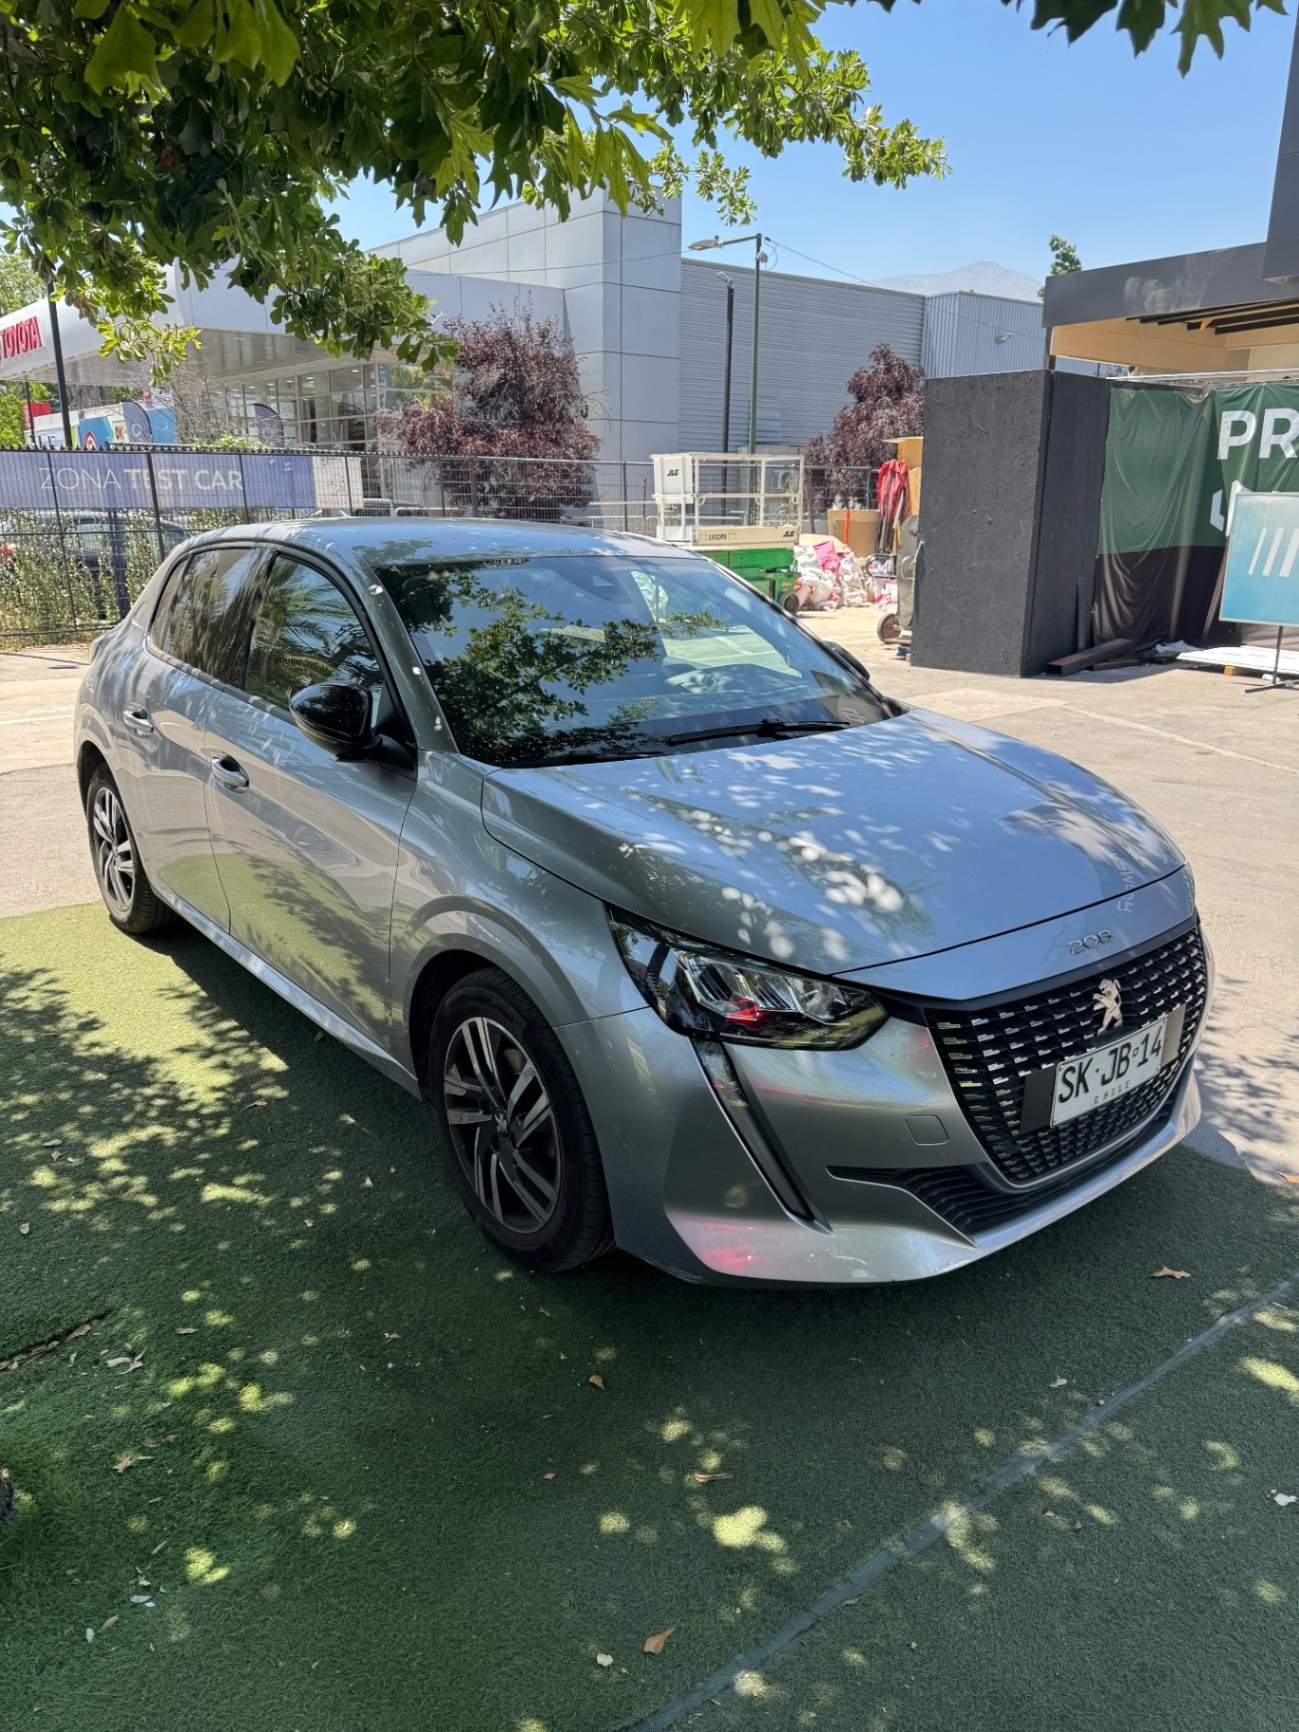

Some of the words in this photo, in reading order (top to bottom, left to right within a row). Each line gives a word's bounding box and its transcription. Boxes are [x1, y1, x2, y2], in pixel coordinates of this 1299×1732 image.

[0, 316, 42, 359] TOYOTA
[38, 467, 121, 489] ZONA
[124, 468, 184, 489] TEST
[194, 470, 244, 489] CAR
[1068, 929, 1112, 955] 208
